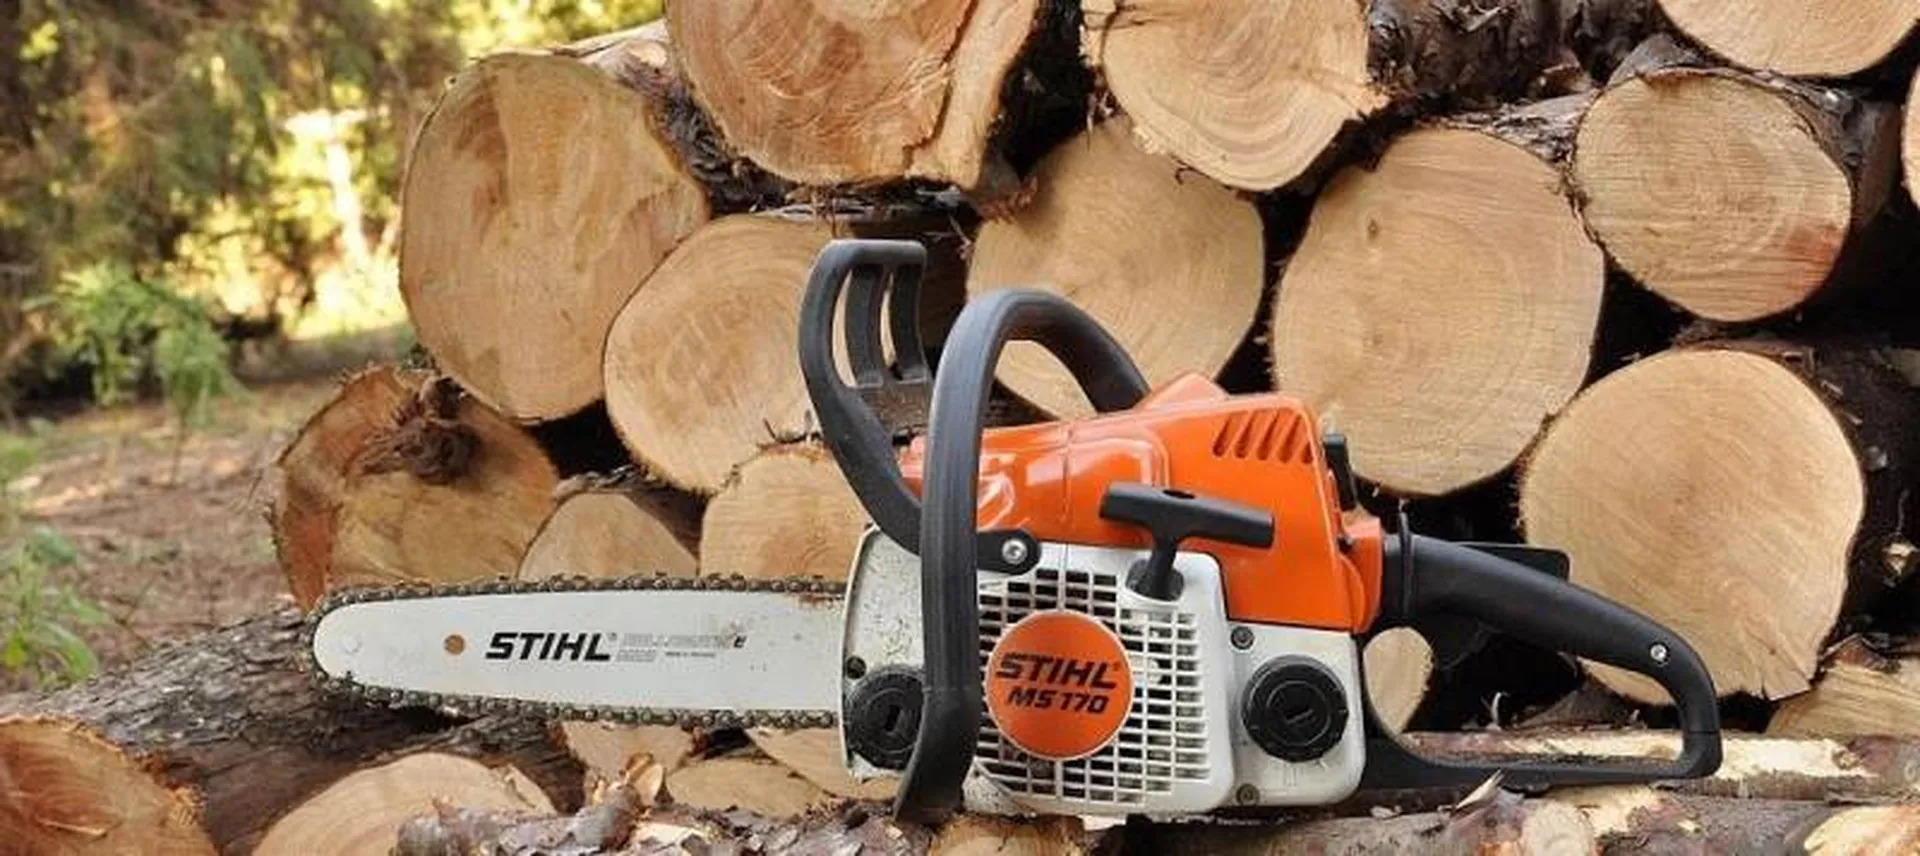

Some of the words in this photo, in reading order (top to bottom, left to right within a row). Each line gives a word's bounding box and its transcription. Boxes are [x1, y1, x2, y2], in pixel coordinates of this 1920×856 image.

[486, 632, 611, 661] STIHL
[996, 652, 1117, 689] STIHL
[1007, 687, 1056, 708] MS
[1059, 692, 1110, 714] 170
